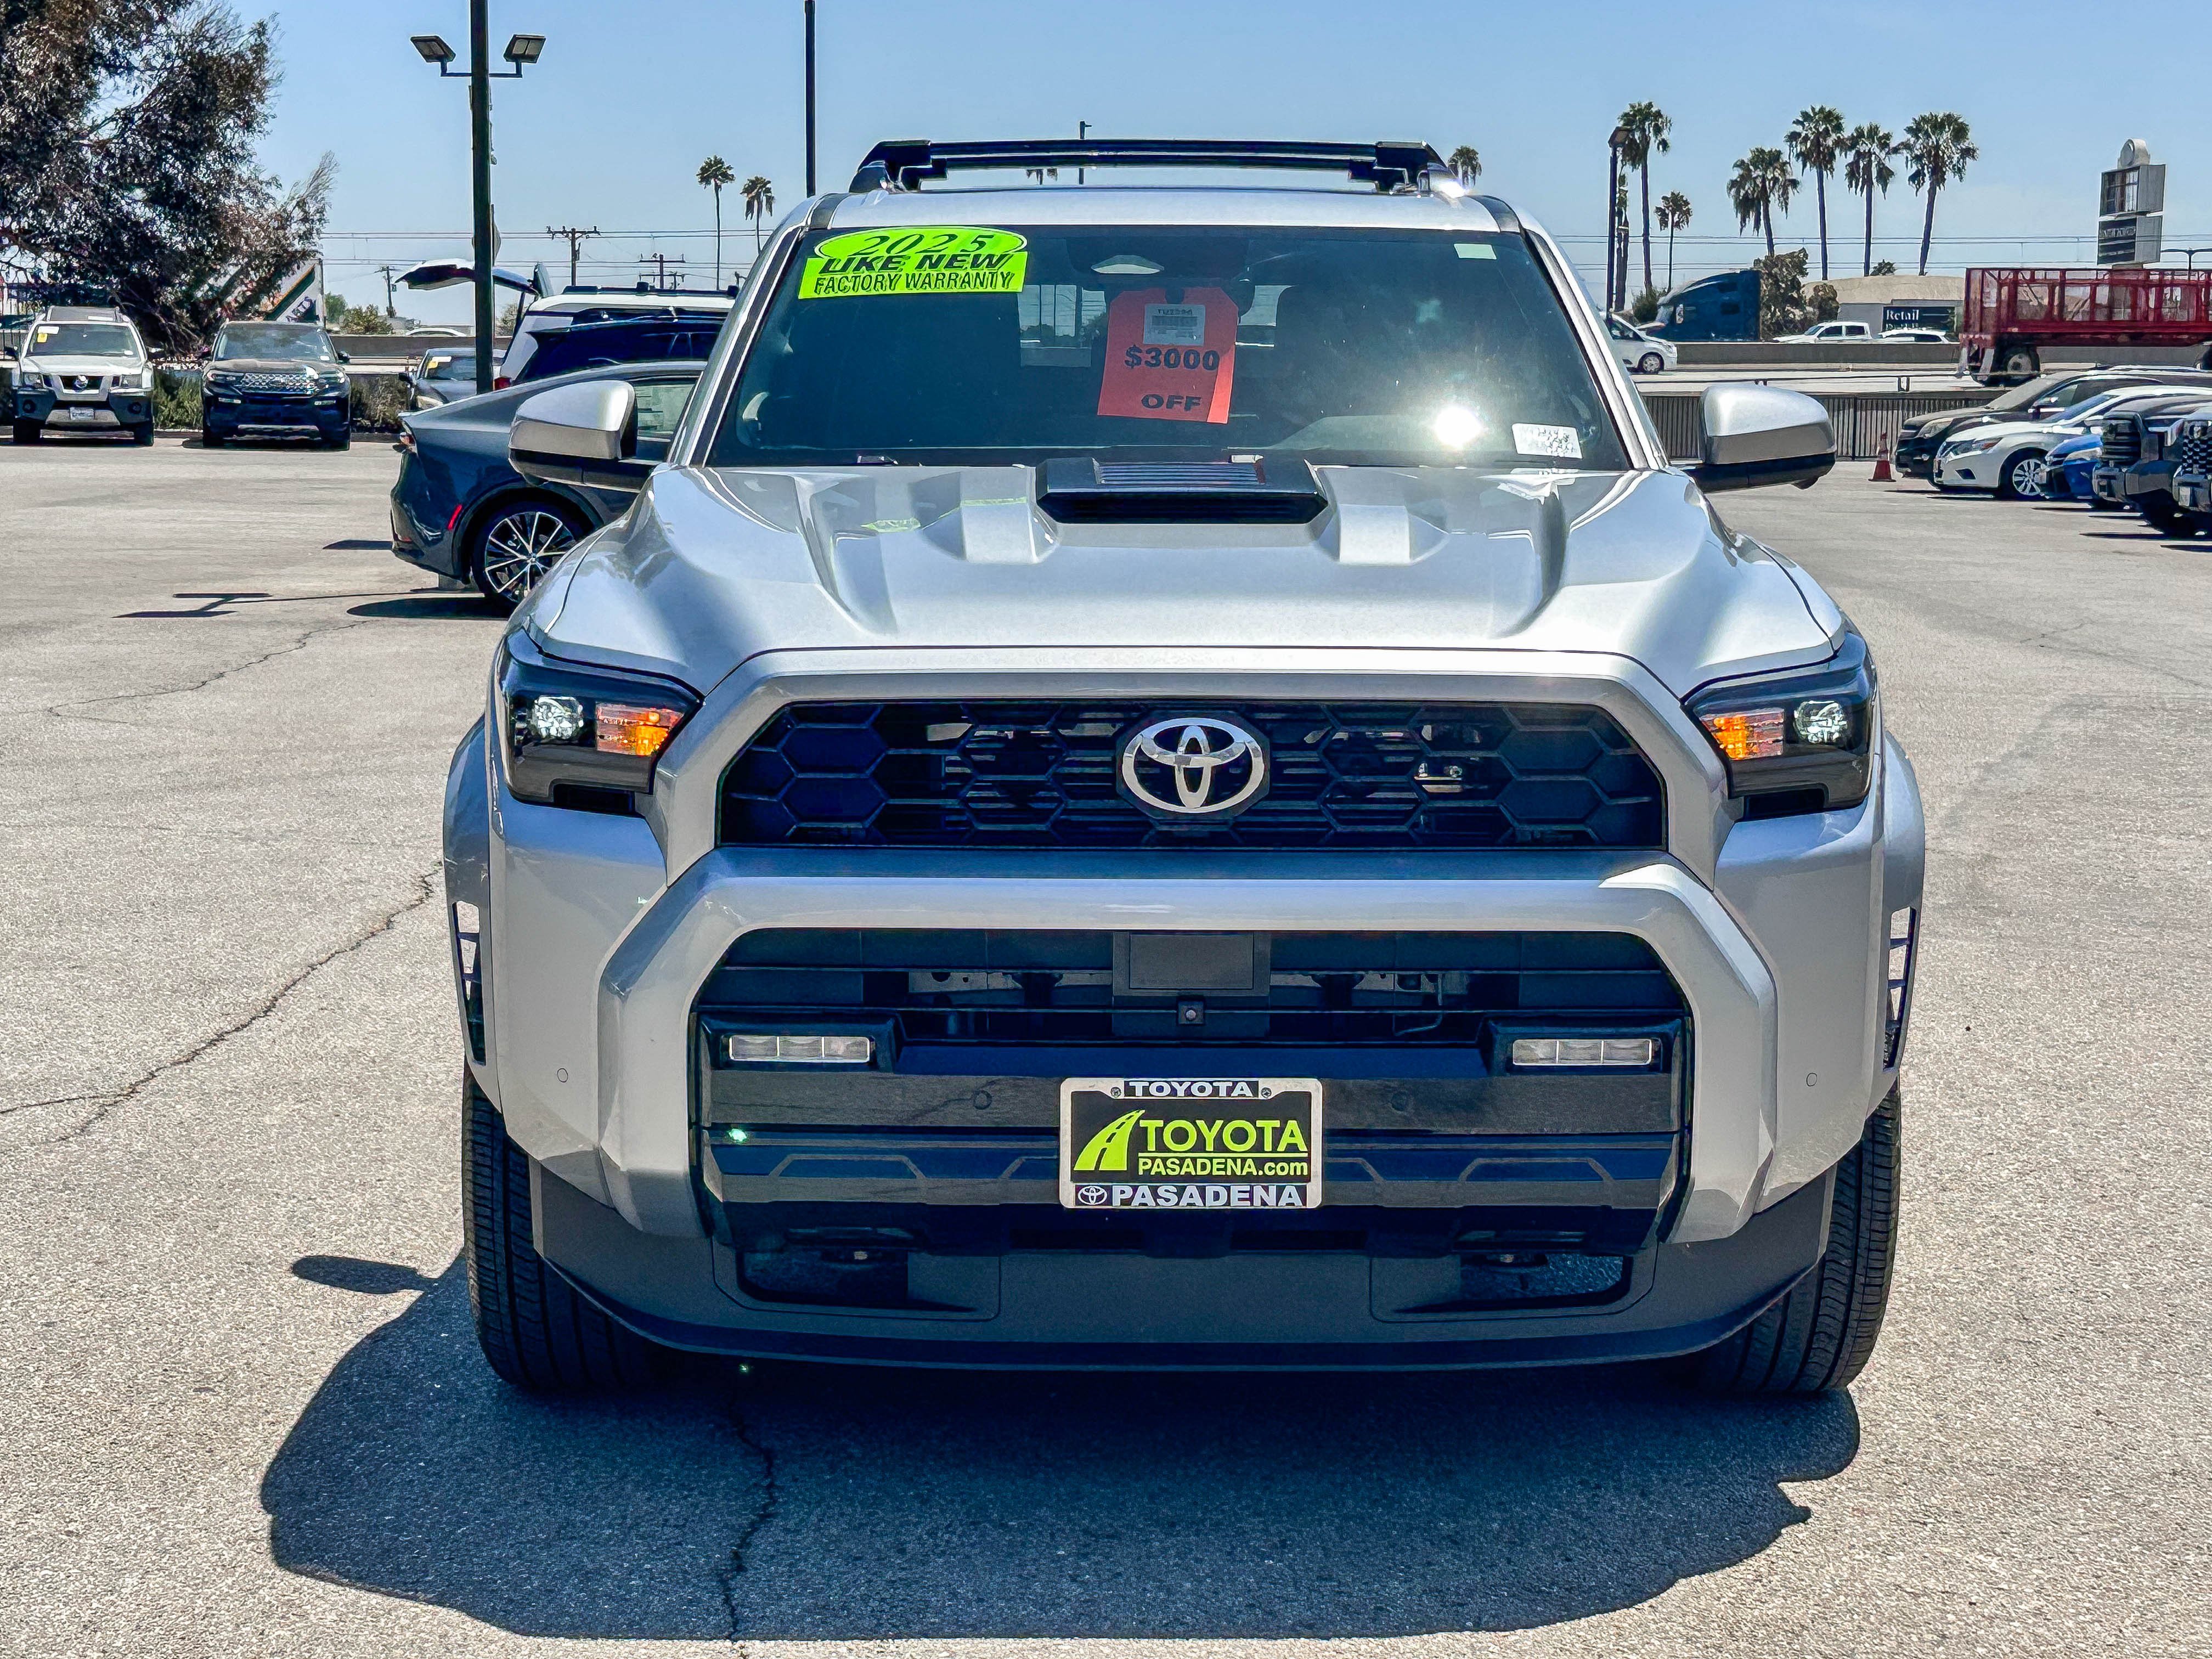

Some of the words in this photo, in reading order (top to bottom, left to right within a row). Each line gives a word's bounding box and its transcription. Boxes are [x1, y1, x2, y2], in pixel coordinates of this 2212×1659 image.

[851, 234, 994, 256] 2025
[819, 255, 910, 274] LIKE
[916, 253, 1014, 272] NEW
[813, 274, 901, 295] FACTORY
[905, 272, 1015, 291] WARRANTY
[1886, 309, 1919, 320] Retail
[1124, 345, 1220, 371] $3000
[1141, 394, 1202, 411] OFF
[1128, 1081, 1254, 1097] TOYOTA
[1139, 1120, 1308, 1152] TOYOTA
[1138, 1158, 1308, 1176] PASADENA.com
[1111, 1185, 1304, 1206] PASADENA
